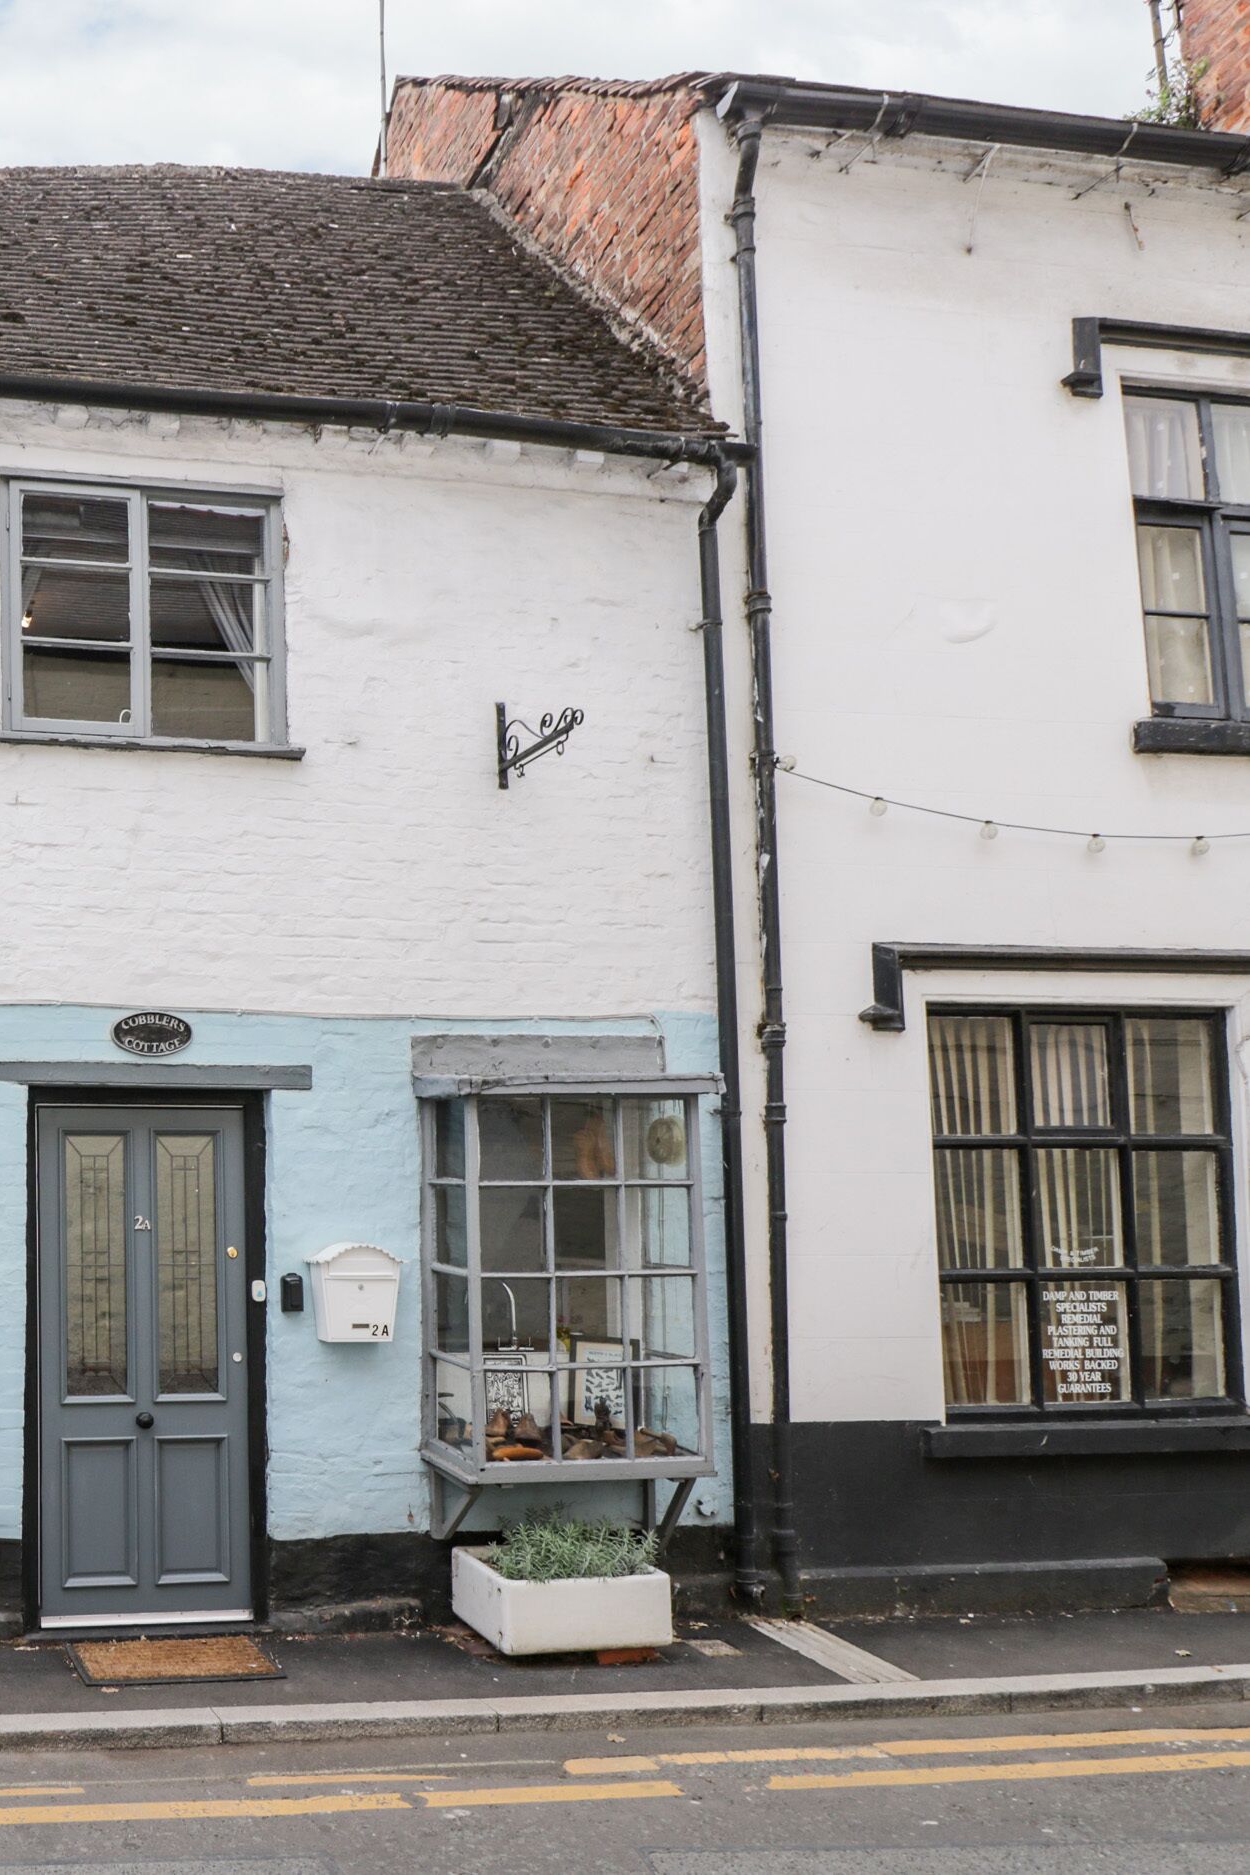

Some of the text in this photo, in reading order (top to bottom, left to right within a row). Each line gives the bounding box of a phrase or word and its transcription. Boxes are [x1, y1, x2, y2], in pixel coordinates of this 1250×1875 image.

[121, 1014, 186, 1032] COBBLERS
[124, 1037, 183, 1053] COTTAGE
[134, 1215, 151, 1230] 2A
[1042, 1290, 1119, 1300] DAMP AND TIMBER
[1055, 1302, 1107, 1312] SPECIALISTS
[1061, 1313, 1103, 1324] REMEDIAL
[1047, 1325, 1117, 1336] PLASTERING AND
[1053, 1336, 1114, 1347] TANKING FULL
[1042, 1348, 1124, 1359] REMEDIAL BUILDING
[1049, 1360, 1118, 1370] WORKS BACKED
[1066, 1371, 1102, 1382] 30 YEAR
[1057, 1383, 1112, 1393] GUARANTEES
